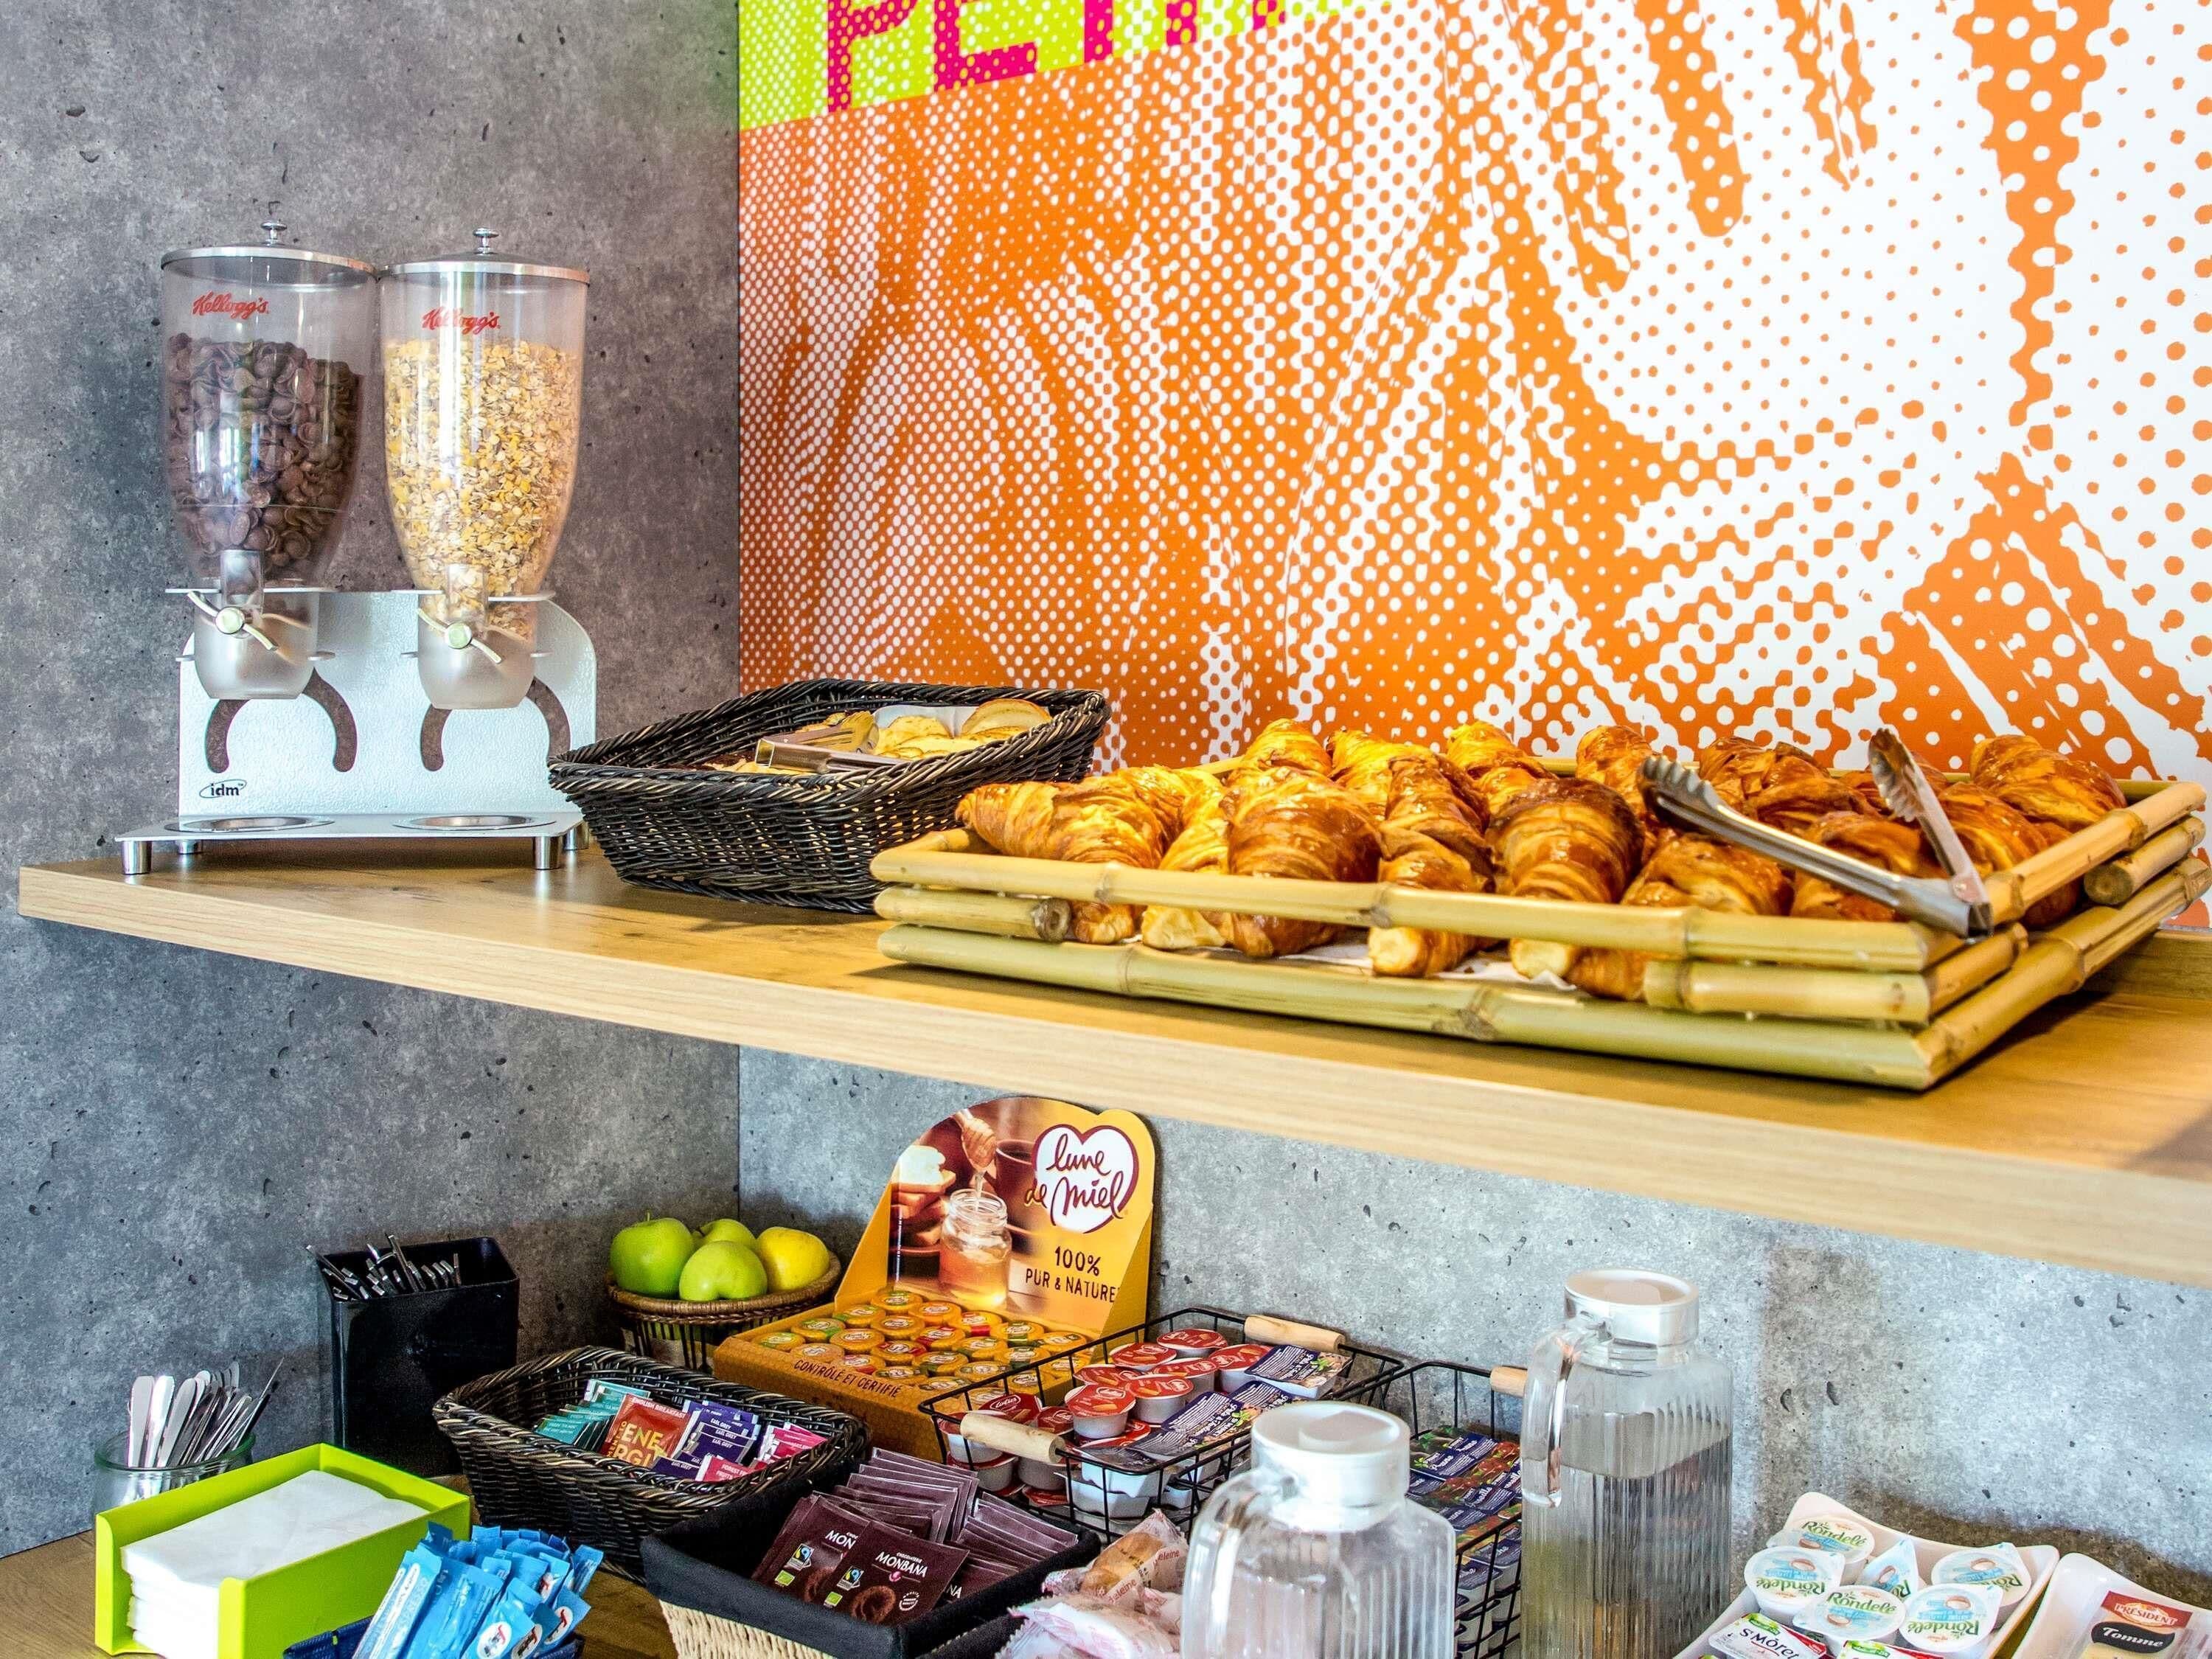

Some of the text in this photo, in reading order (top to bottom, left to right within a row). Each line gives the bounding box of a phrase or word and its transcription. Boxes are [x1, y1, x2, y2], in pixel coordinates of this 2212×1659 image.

[192, 290, 268, 320] Kellogg's
[210, 782, 240, 796] idm
[1055, 1246, 1102, 1276] 100%
[1026, 1268, 1120, 1303] PUR & NATURE
[794, 1360, 903, 1398] CONTRÔLÉ ET CERTIFIÉ
[654, 1405, 686, 1419] BREAKFAST
[875, 1551, 928, 1577] MONBANA
[1826, 1592, 1897, 1614] Rondelé
[2115, 1603, 2177, 1626] PRÉSIDENT
[2102, 1627, 2164, 1647] Tomme
